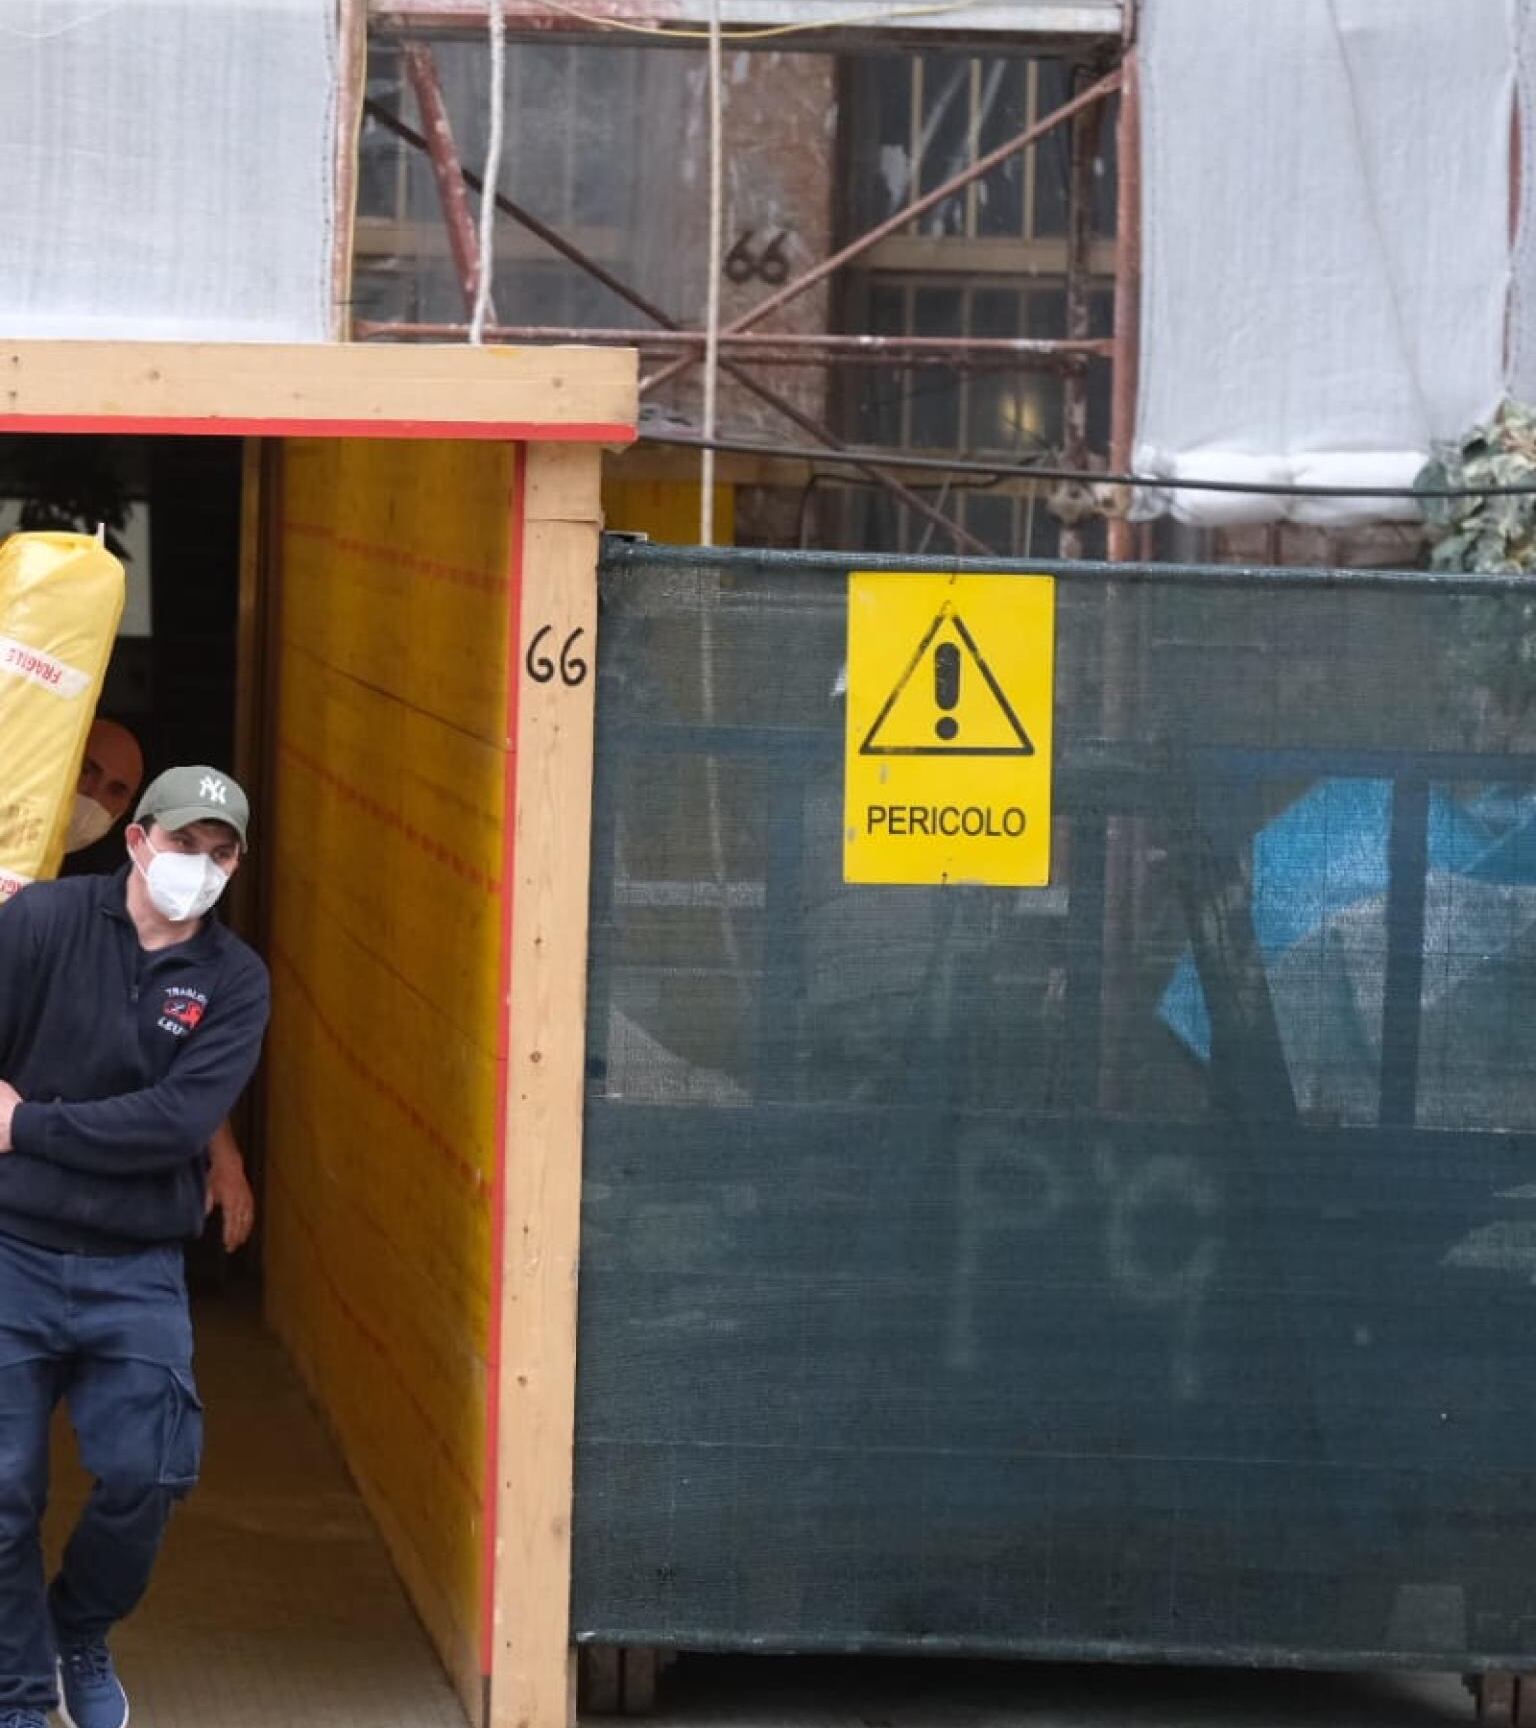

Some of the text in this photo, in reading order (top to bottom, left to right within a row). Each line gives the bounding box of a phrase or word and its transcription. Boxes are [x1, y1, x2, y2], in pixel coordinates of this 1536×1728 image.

[723, 229, 789, 285] 66
[4, 647, 63, 685] FRAGILE
[525, 624, 589, 687] 66
[199, 775, 227, 804] NY
[867, 804, 1027, 839] PERICOLO
